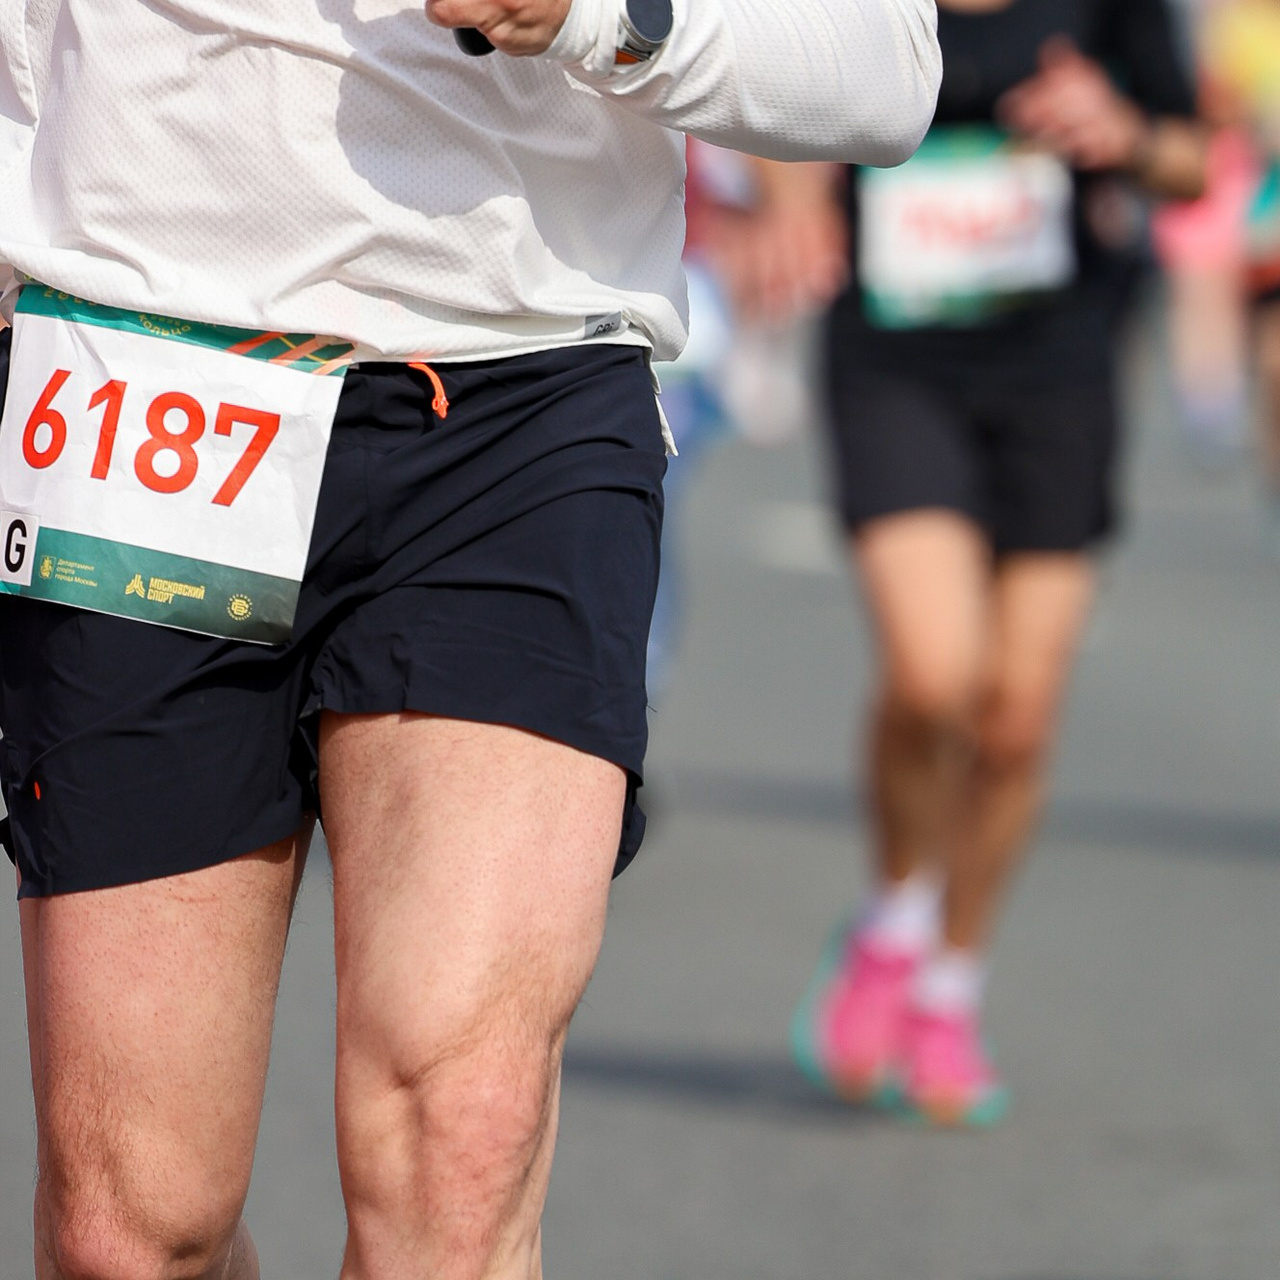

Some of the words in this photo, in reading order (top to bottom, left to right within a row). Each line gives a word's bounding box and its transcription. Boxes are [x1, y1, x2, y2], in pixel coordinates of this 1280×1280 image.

[22, 368, 281, 507] 6187
[5, 519, 27, 573] G
[147, 588, 174, 604] СПОРТ
[149, 577, 205, 599] МОСКОВСКИЙ
